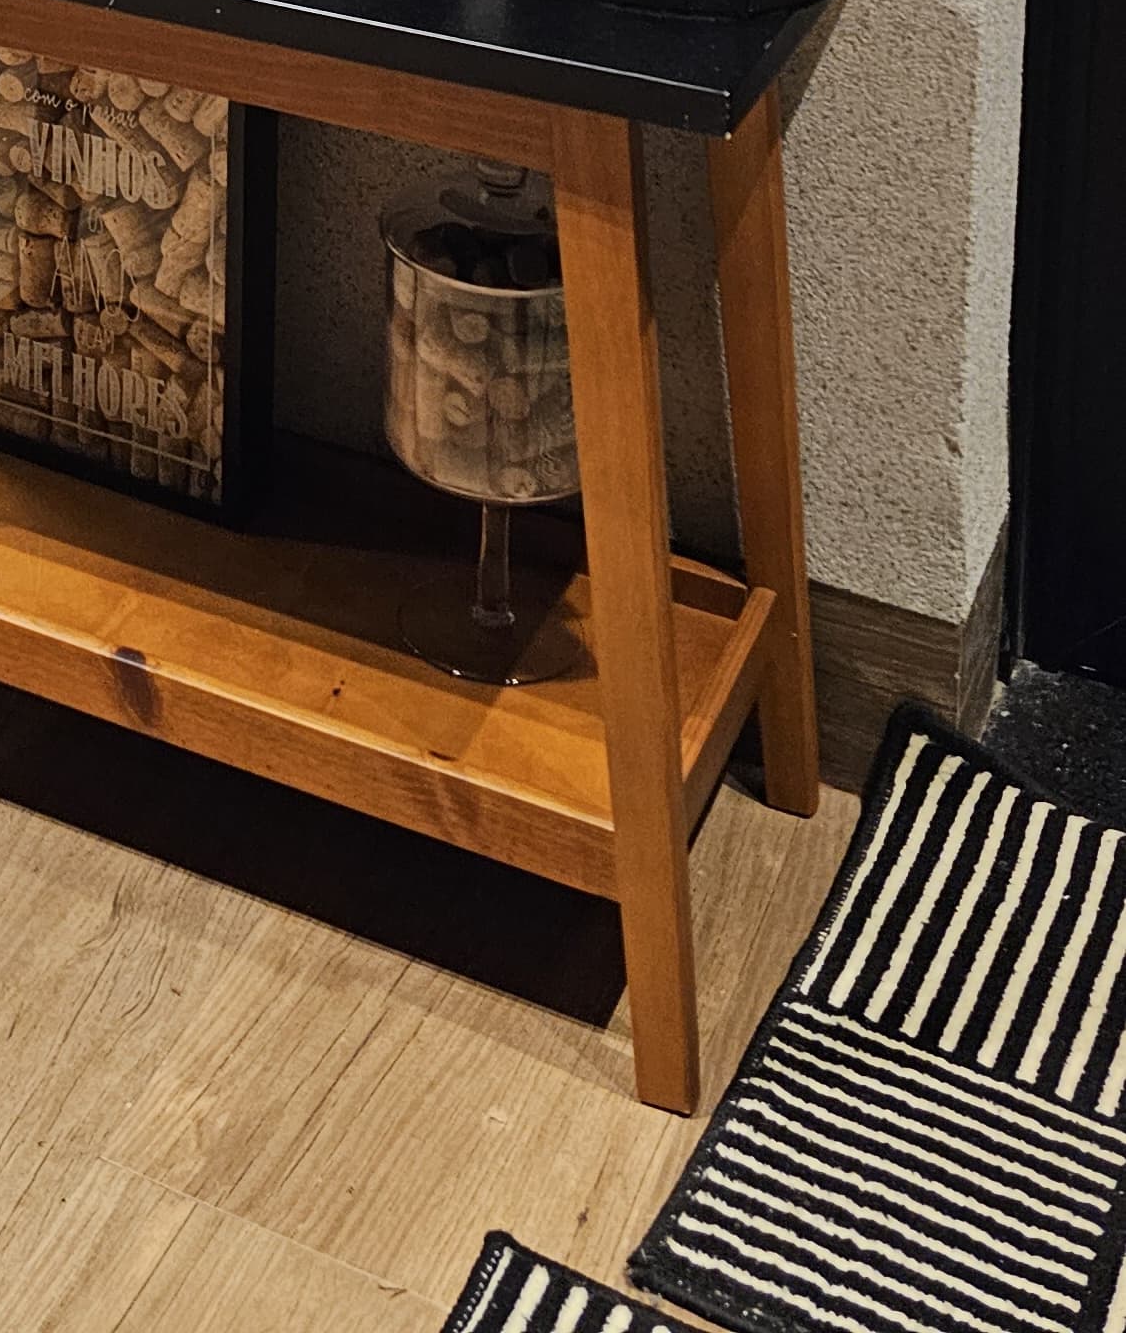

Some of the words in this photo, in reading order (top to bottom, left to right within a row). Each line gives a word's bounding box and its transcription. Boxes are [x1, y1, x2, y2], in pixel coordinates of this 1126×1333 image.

[24, 87, 61, 108] com
[65, 98, 78, 111] o
[82, 102, 138, 129] passar
[27, 118, 178, 210] VINHOS
[50, 235, 141, 323] ANOS
[3, 332, 189, 439] MELHORES
